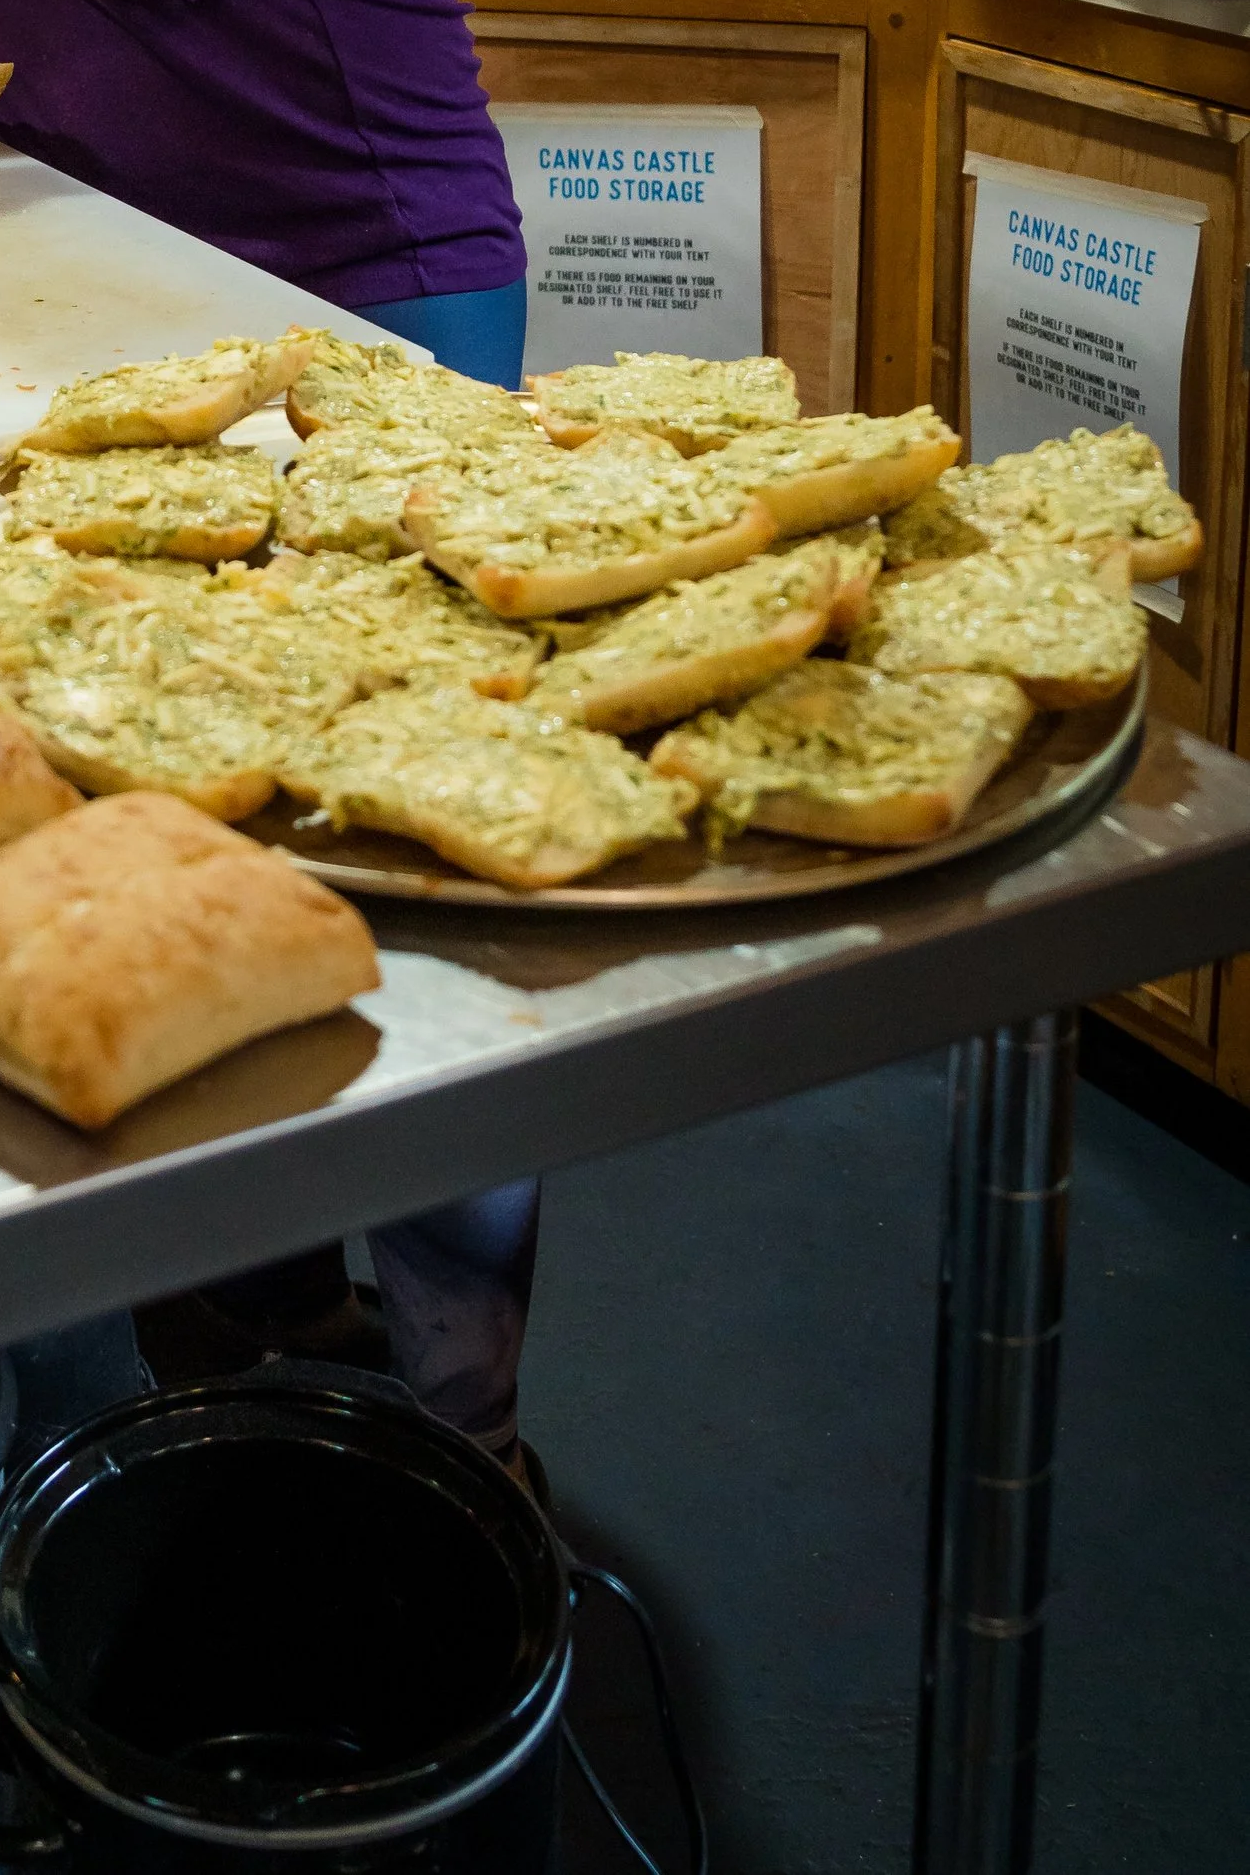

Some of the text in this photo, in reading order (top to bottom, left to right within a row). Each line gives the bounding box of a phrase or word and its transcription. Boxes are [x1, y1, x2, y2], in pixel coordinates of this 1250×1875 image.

[539, 148, 715, 174] CANVAS CASTLE
[550, 177, 705, 203] FOOD STORAGE
[549, 246, 709, 261] CORRESPONDENCE WITH YOUR TENT
[565, 235, 692, 248] EACH SHELF IS NUMBERED IN
[1009, 210, 1157, 275] CANVAS CASTLE
[538, 282, 592, 293] DESIGNATED
[630, 286, 649, 296] FEEL
[653, 286, 675, 297] FREE
[679, 287, 690, 298] TO
[693, 289, 710, 298] USE
[714, 289, 722, 299] IT
[545, 270, 715, 286] IF THERE IS FOOD REMAINING ON YOUR
[1013, 243, 1143, 305] FOOD STORAGE
[562, 295, 698, 310] OR ADD IT TO THE FREE SHELF
[1006, 317, 1137, 371] CORRESPONDENCE WITH YOUR TENT
[1020, 308, 1124, 353] EACH SHELF IS NUMBERED IN
[997, 352, 1041, 376] DESIGNATED
[1069, 378, 1086, 394] FEEL
[1089, 388, 1106, 401] FREE
[1109, 393, 1119, 406] TO
[1121, 398, 1136, 412] USE
[1138, 404, 1146, 415] IT
[1003, 342, 1141, 400] IF THERE IS FOOD REMAINING ON YOUR
[1016, 372, 1126, 421] OR ADD IT TO THE FREE SHELF
